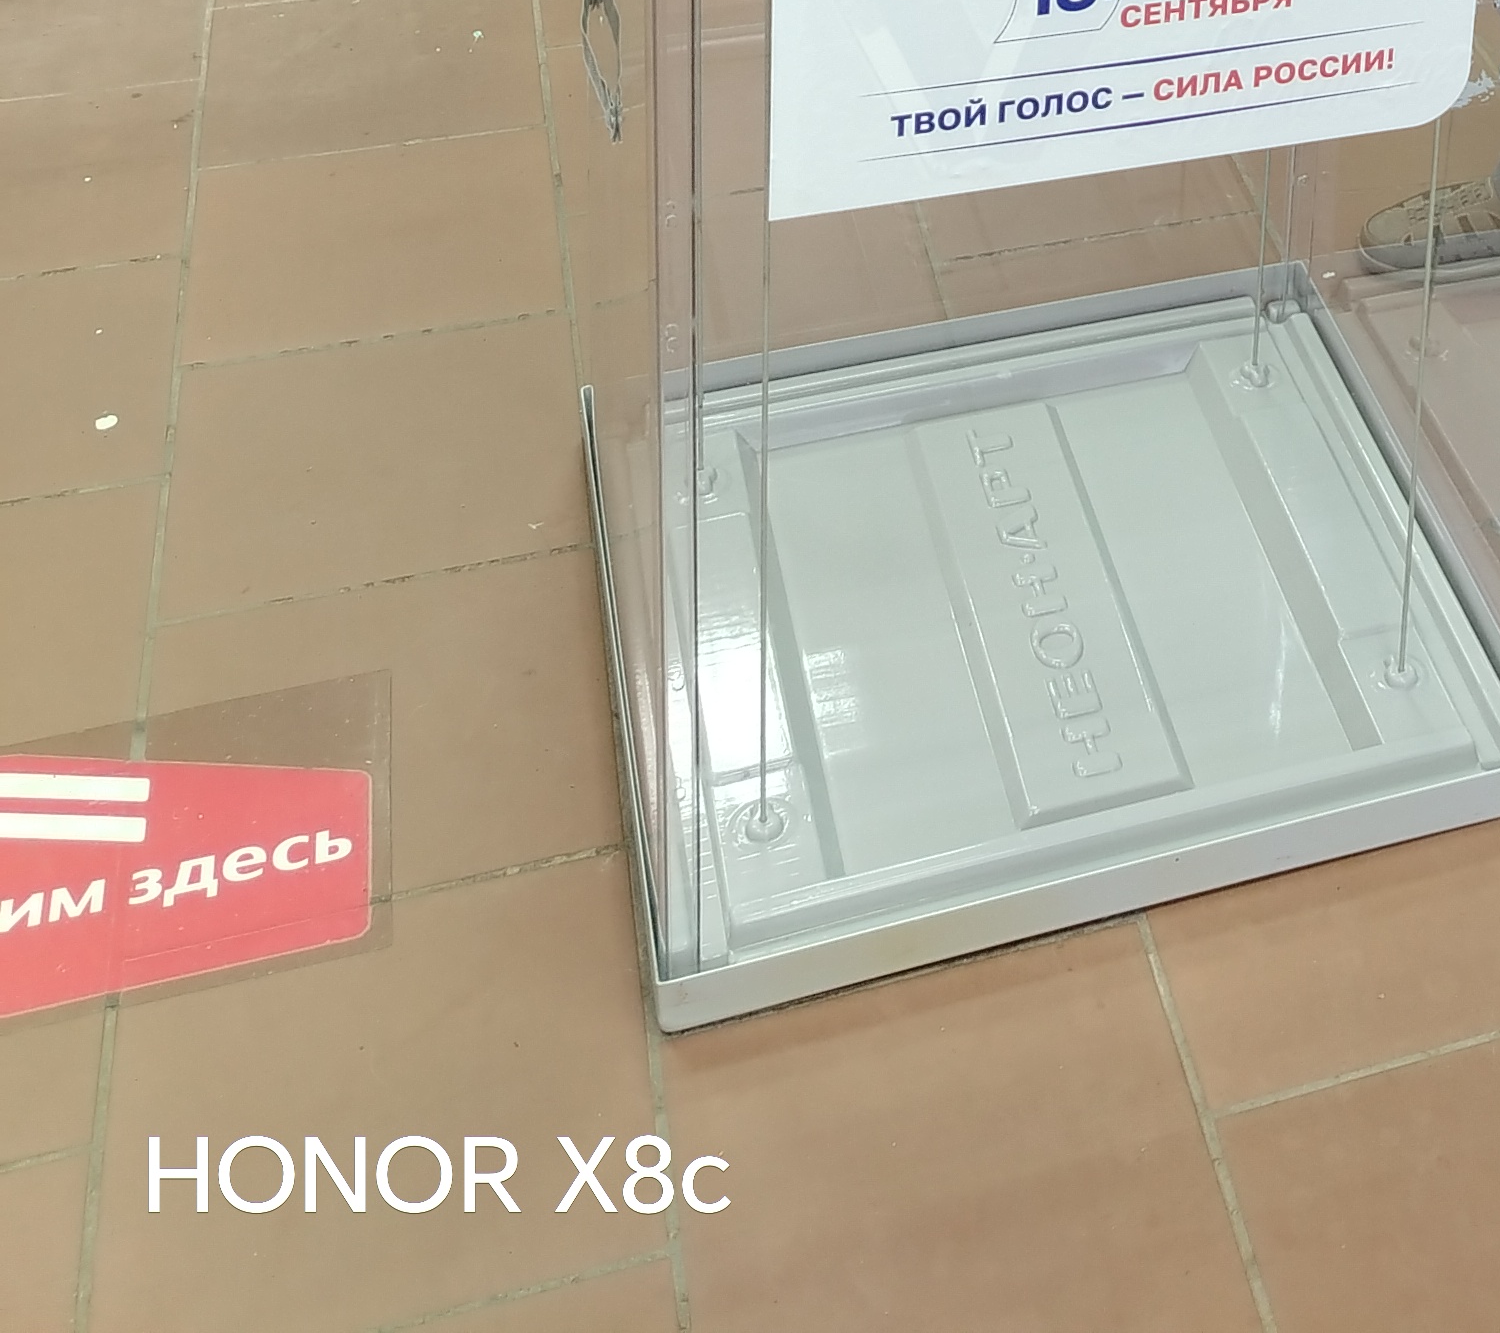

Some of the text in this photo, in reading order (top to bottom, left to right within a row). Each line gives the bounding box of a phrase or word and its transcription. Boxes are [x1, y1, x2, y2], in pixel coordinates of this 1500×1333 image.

[891, 100, 988, 139] ТВОЙ
[997, 85, 1115, 125] ГОЛОС
[1152, 67, 1244, 103] СИЛА
[1253, 46, 1396, 87] РОССИИ!
[129, 829, 354, 909] здесь
